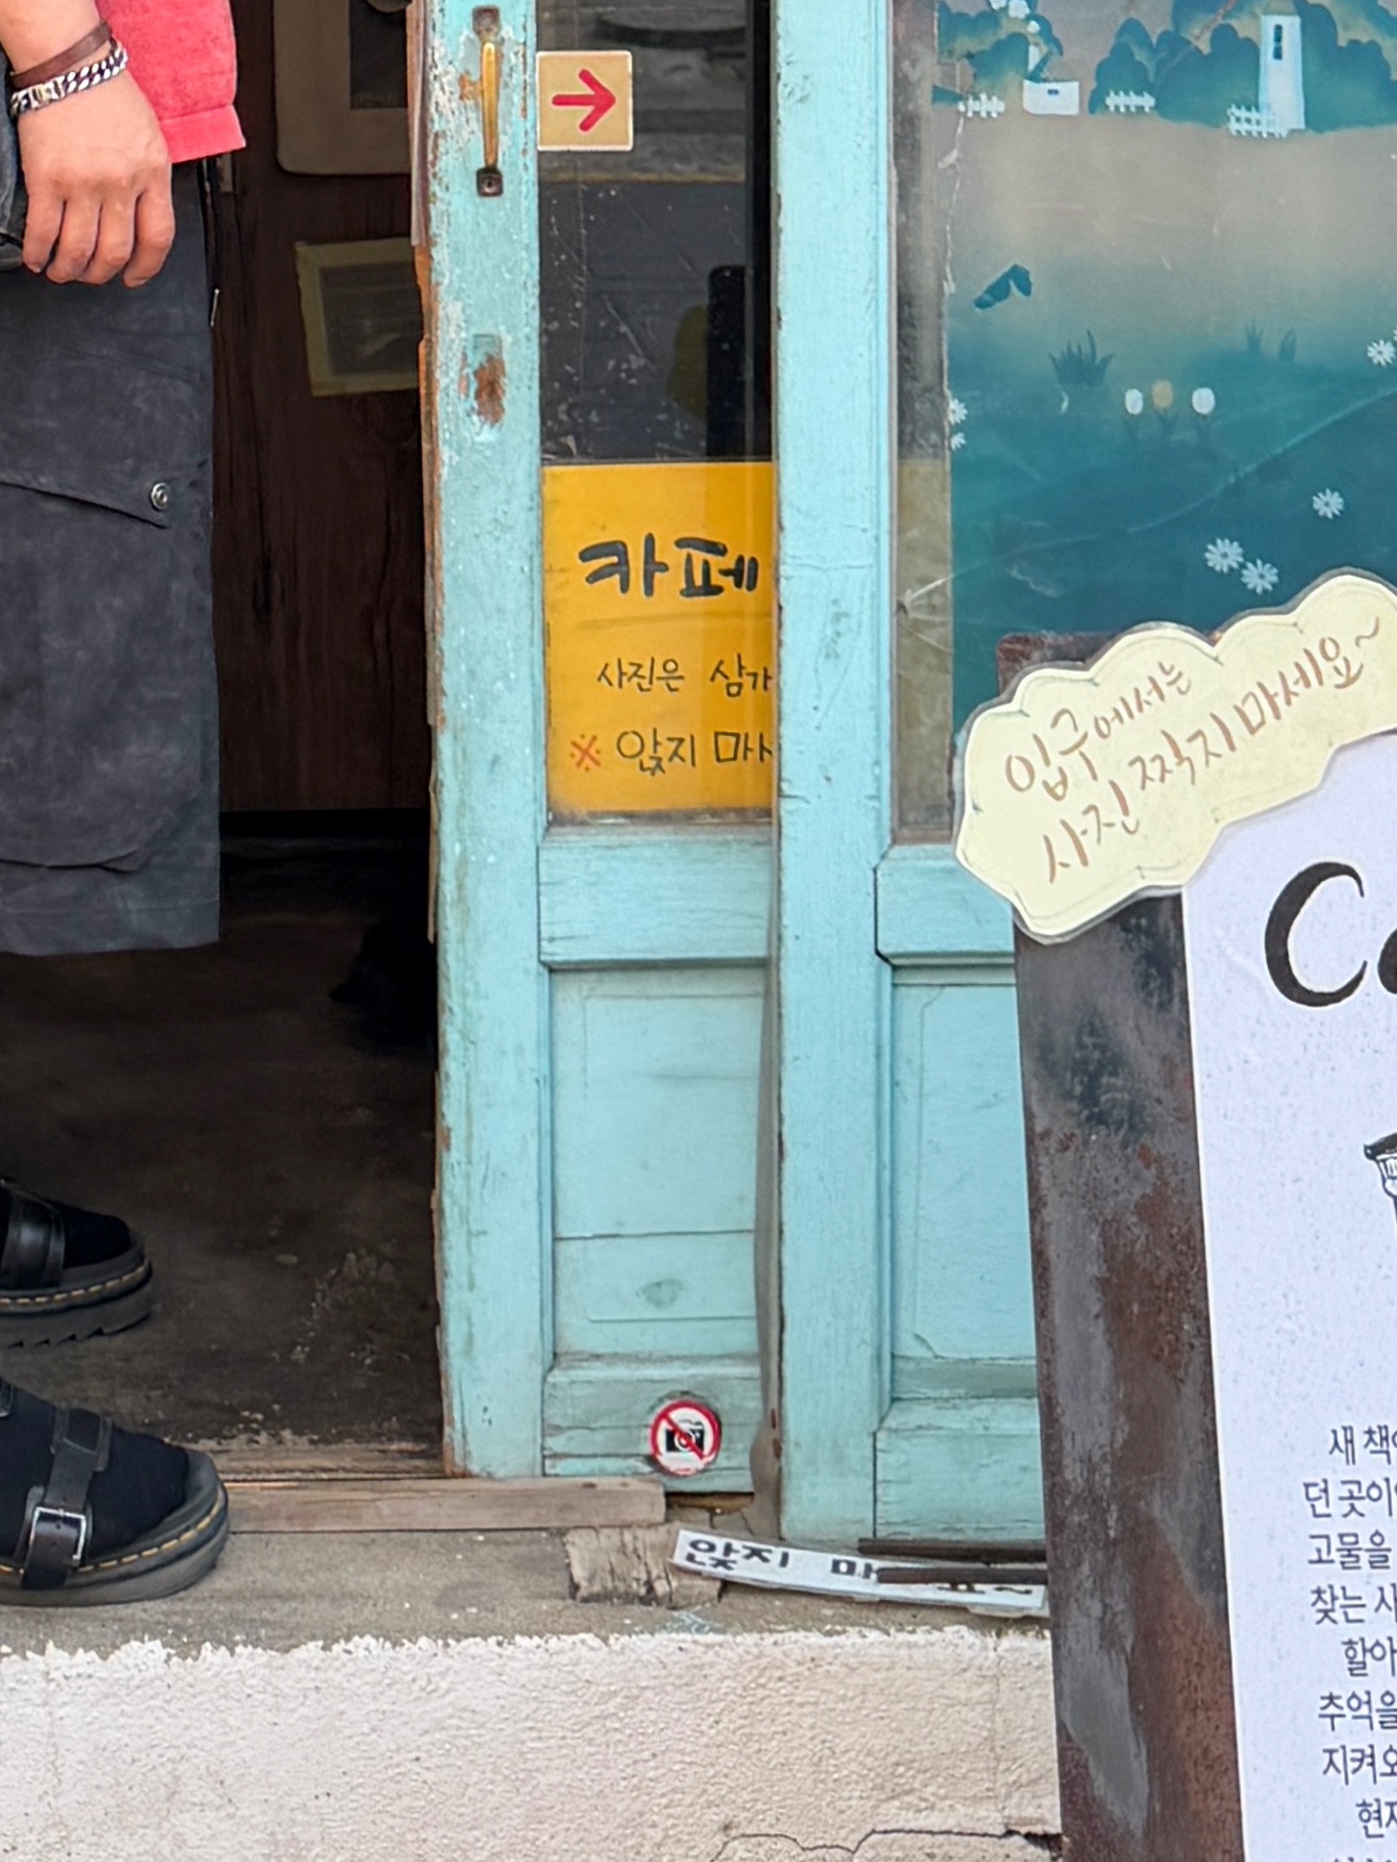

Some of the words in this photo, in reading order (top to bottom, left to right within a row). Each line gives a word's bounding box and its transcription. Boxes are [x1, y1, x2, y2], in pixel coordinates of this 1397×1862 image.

[578, 532, 760, 599] 카페
[596, 656, 686, 693] 사진은
[1042, 780, 1141, 885] 사진
[1302, 1477, 1333, 1519] 던
[1337, 1475, 1397, 1519] 곳이
[1307, 1528, 1393, 1571] 고물을
[1310, 1583, 1368, 1625] 찾는
